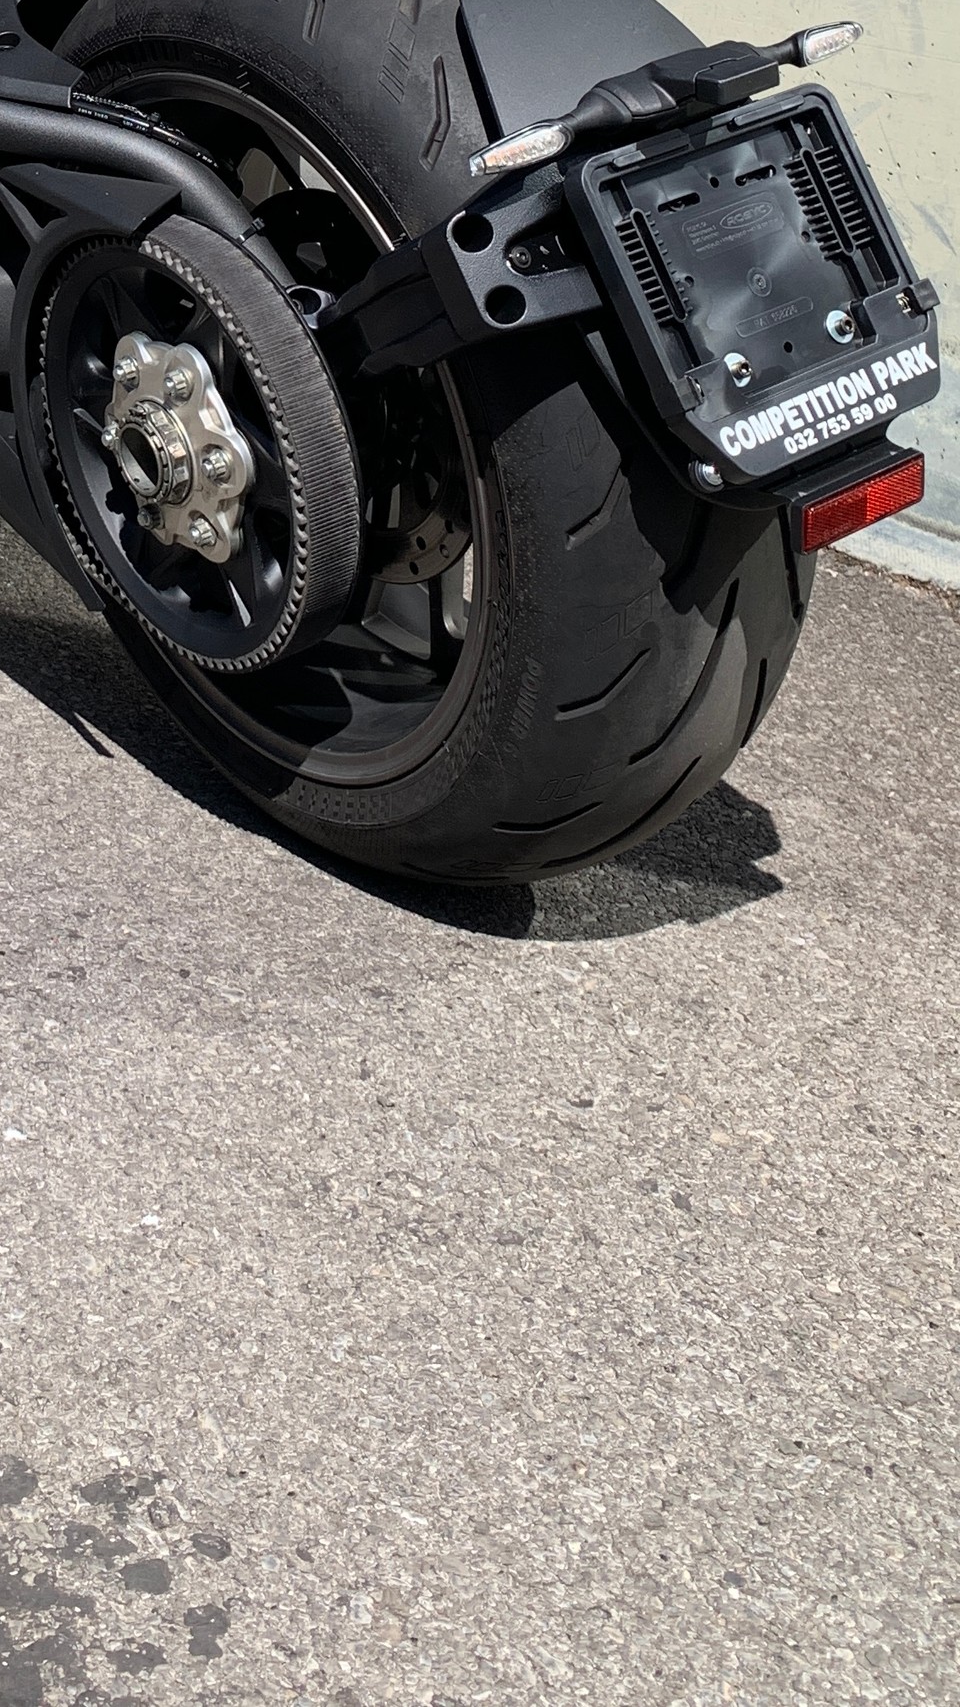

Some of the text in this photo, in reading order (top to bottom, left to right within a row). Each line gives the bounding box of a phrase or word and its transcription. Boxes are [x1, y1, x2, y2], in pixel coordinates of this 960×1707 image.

[719, 342, 938, 457] COMPETITION PARK
[783, 393, 898, 454] 032 753 59 00
